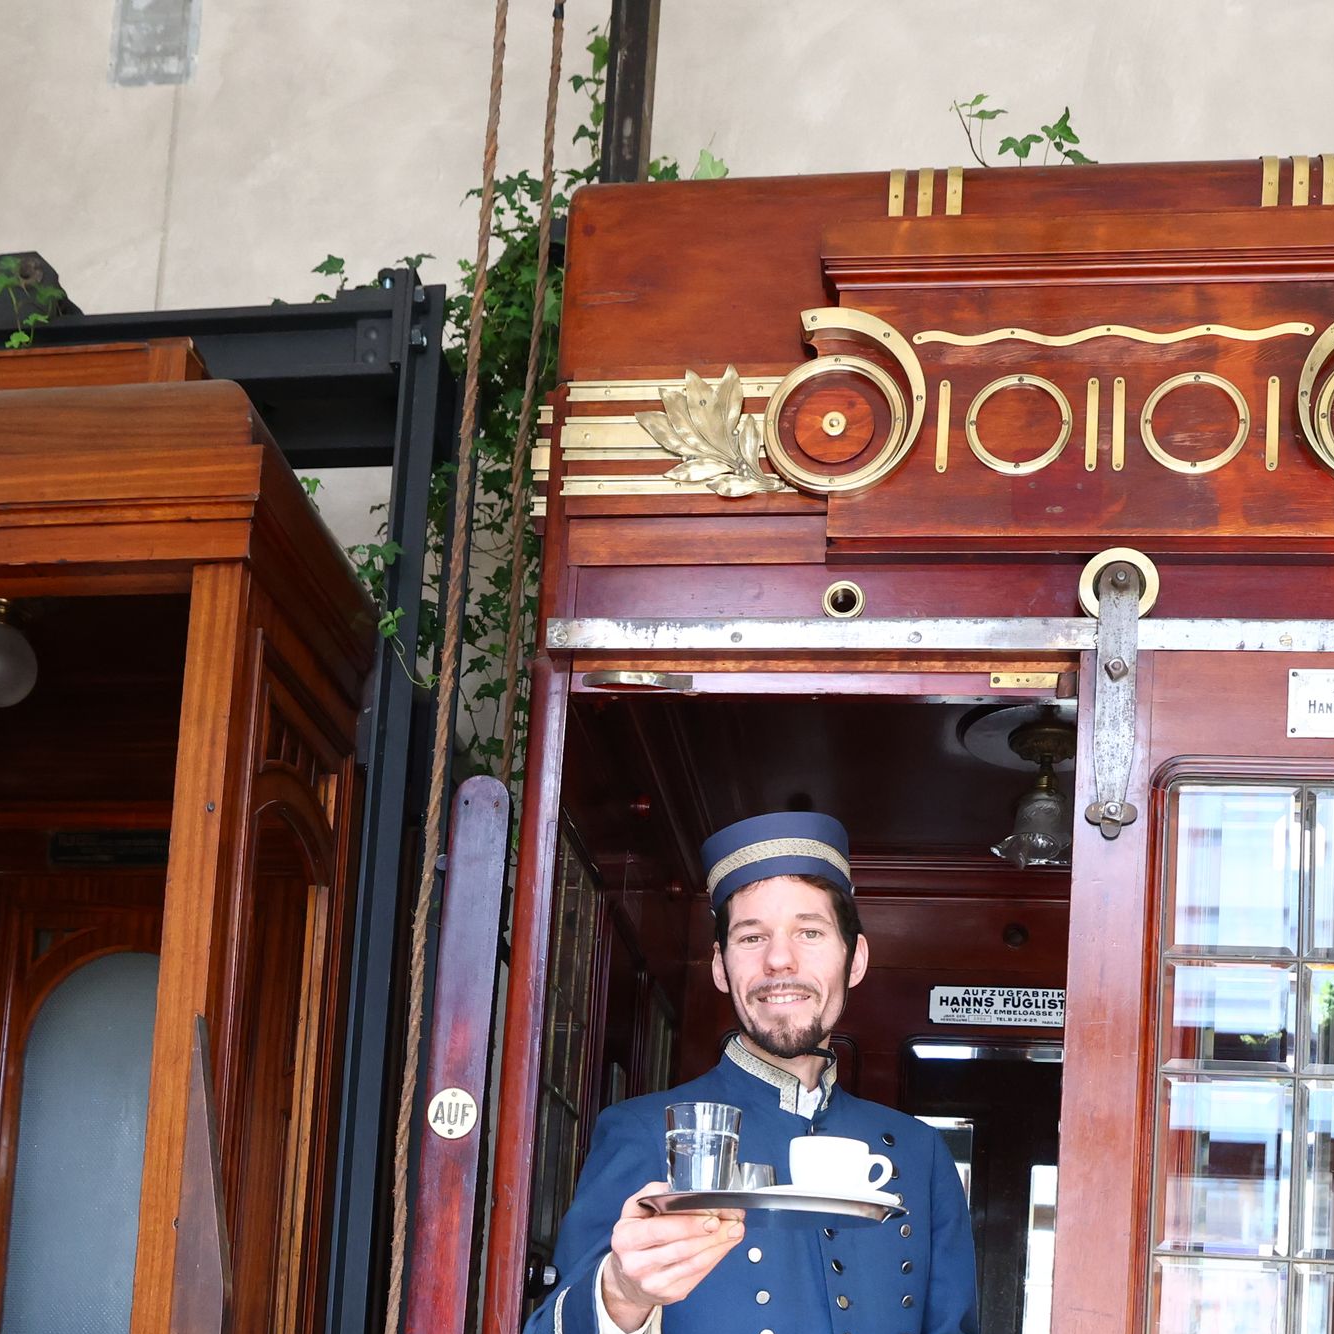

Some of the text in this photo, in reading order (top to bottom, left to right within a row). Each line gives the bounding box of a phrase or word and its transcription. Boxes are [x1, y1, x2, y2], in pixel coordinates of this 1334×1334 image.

[963, 988, 1064, 999] AUFZUGFABRIK
[939, 996, 1065, 1010] HANNS FÜGLIST
[432, 1101, 473, 1127] AUF
